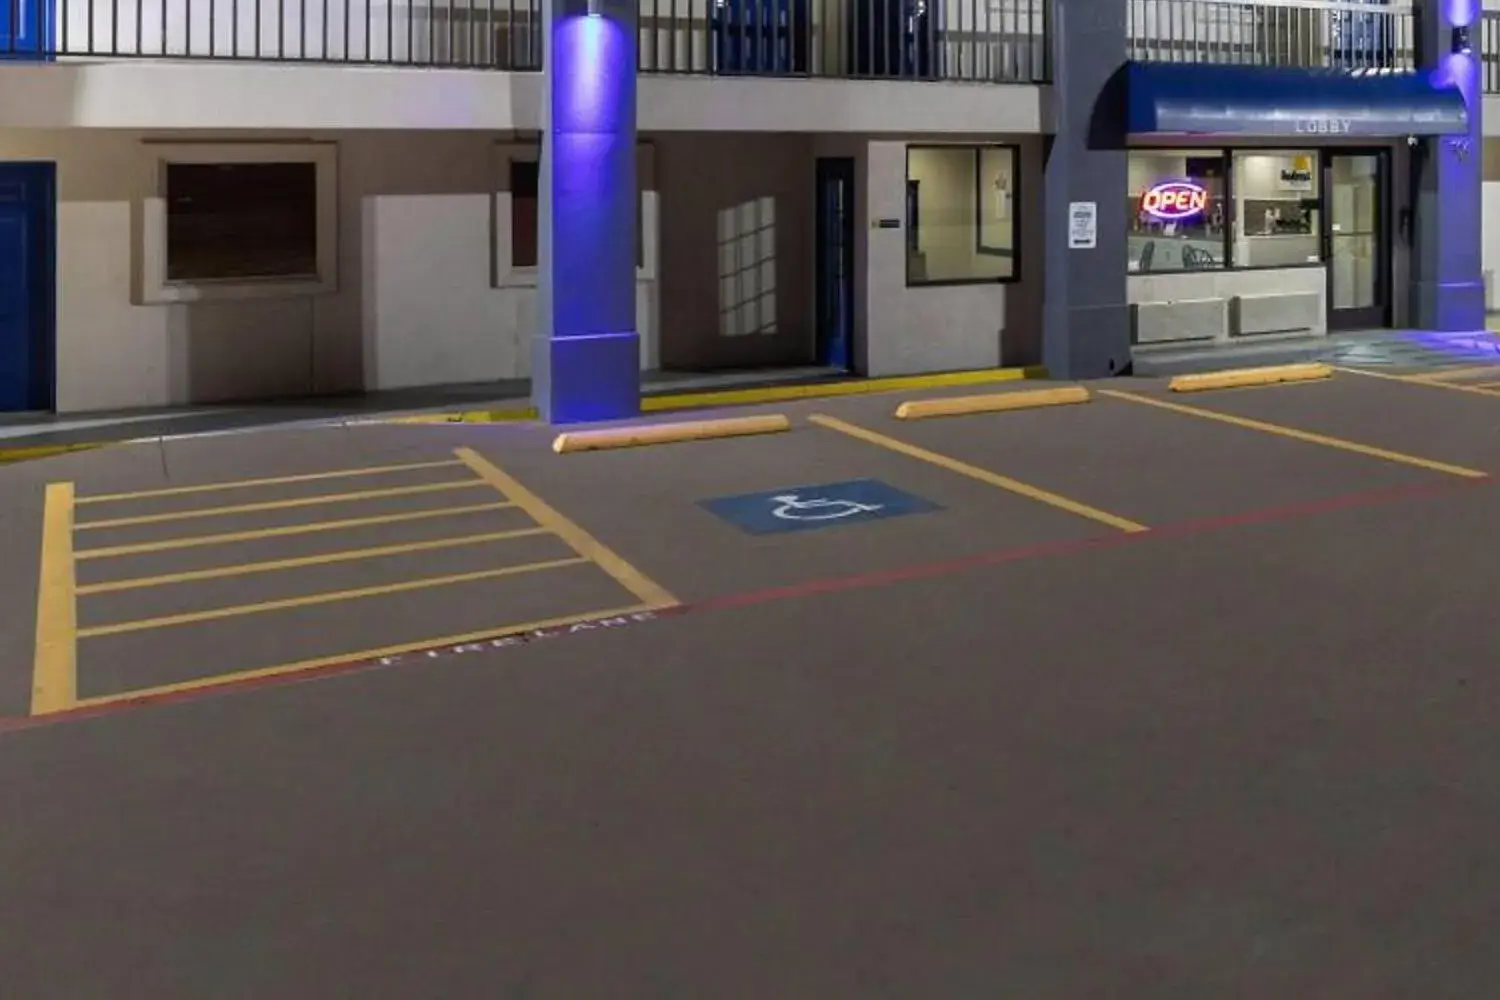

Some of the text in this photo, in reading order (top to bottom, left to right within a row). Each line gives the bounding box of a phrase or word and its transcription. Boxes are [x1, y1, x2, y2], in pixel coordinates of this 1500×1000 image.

[1295, 119, 1351, 132] LOBBY
[1143, 191, 1207, 210] OPEN
[380, 612, 656, 665] FIRE LANE
